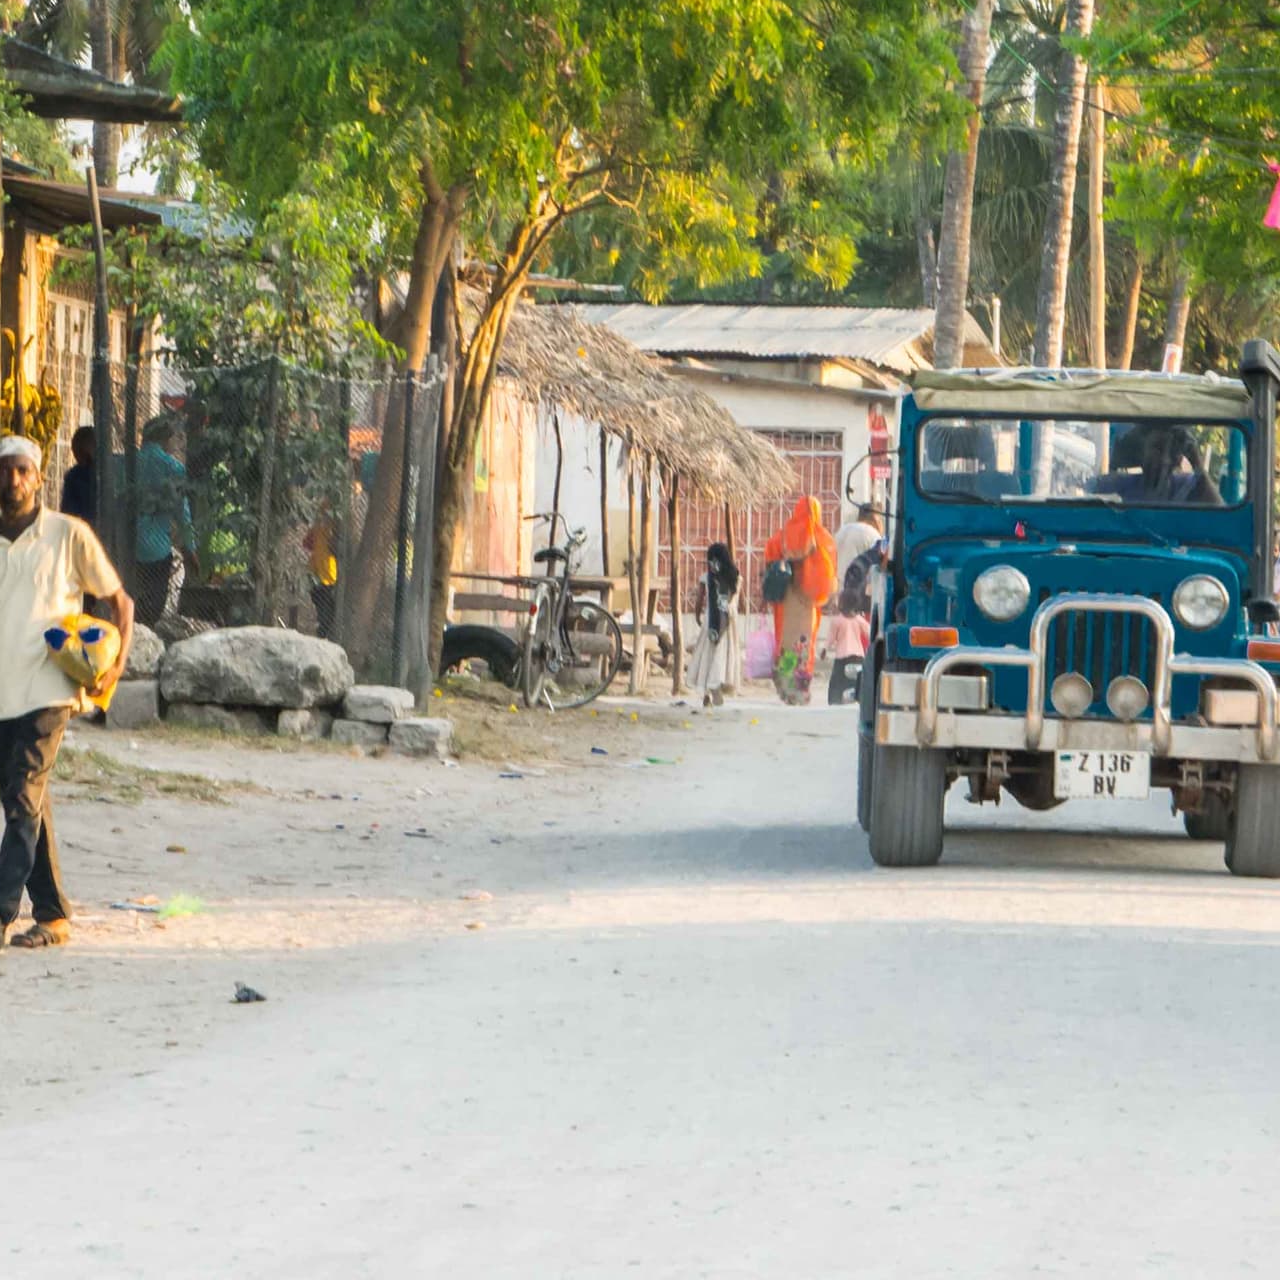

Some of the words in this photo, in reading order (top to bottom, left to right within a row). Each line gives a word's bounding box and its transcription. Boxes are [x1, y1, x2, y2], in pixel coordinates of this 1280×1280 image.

[1078, 753, 1089, 773] Z
[1100, 753, 1132, 773] 136
[1094, 775, 1117, 795] BV
